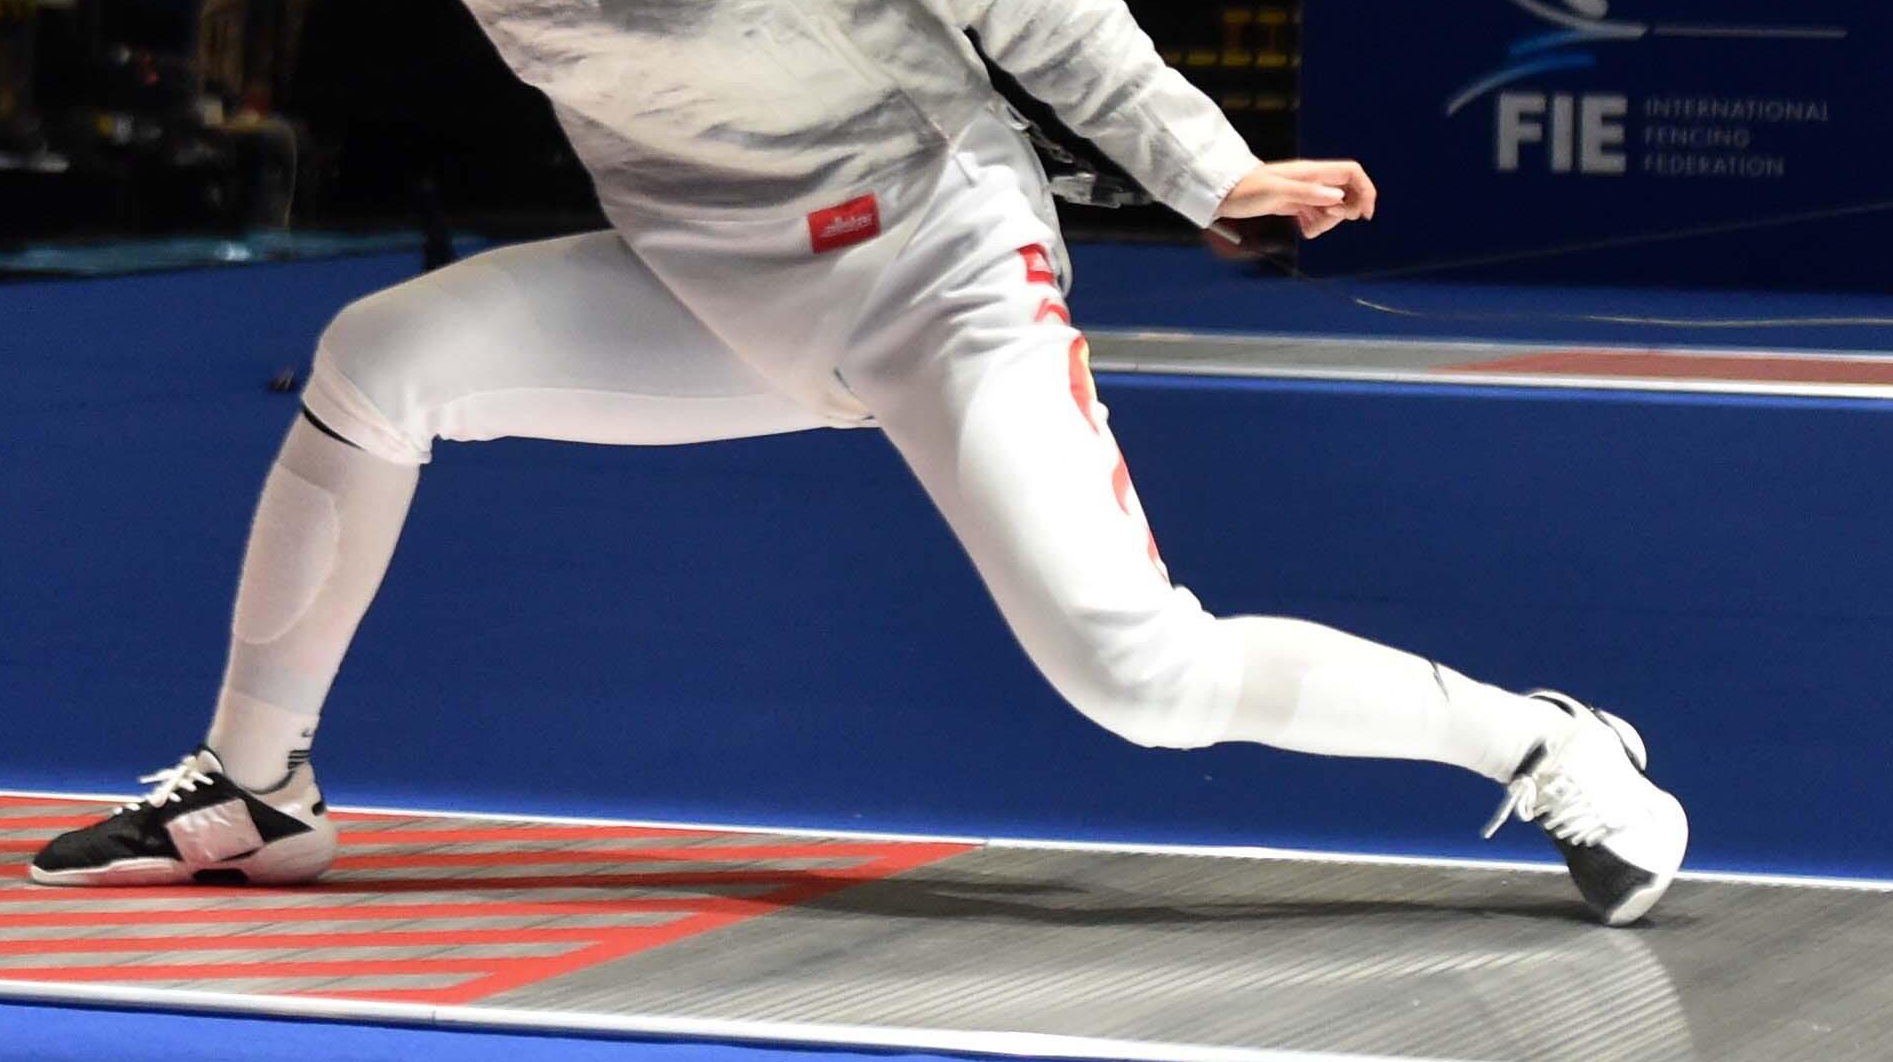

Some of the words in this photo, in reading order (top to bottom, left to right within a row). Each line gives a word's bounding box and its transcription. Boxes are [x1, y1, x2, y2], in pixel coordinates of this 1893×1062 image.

[1644, 97, 1829, 123] INTERNATIONAL
[1496, 91, 1629, 174] FIE
[1644, 128, 1751, 149] FENCING
[1644, 154, 1785, 178] FEDERATION
